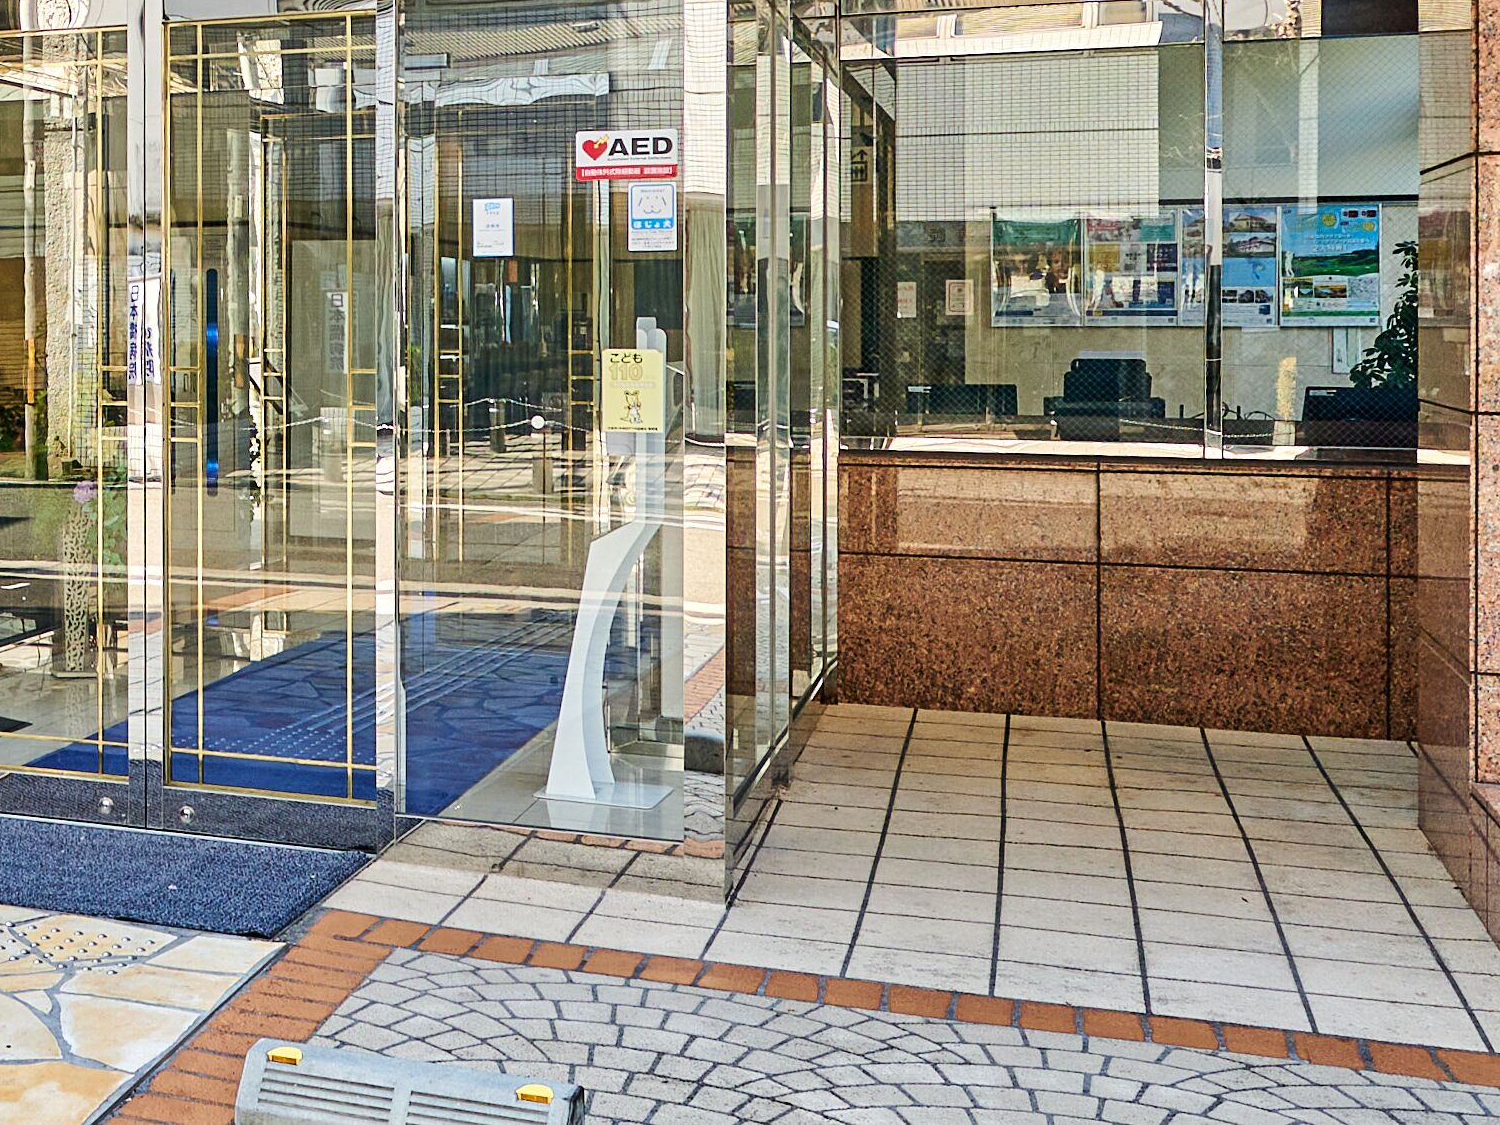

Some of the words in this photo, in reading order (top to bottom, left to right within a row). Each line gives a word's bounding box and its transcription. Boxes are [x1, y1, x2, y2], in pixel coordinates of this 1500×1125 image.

[608, 136, 673, 156] AED
[610, 353, 643, 364] こども
[608, 364, 644, 381] 110
